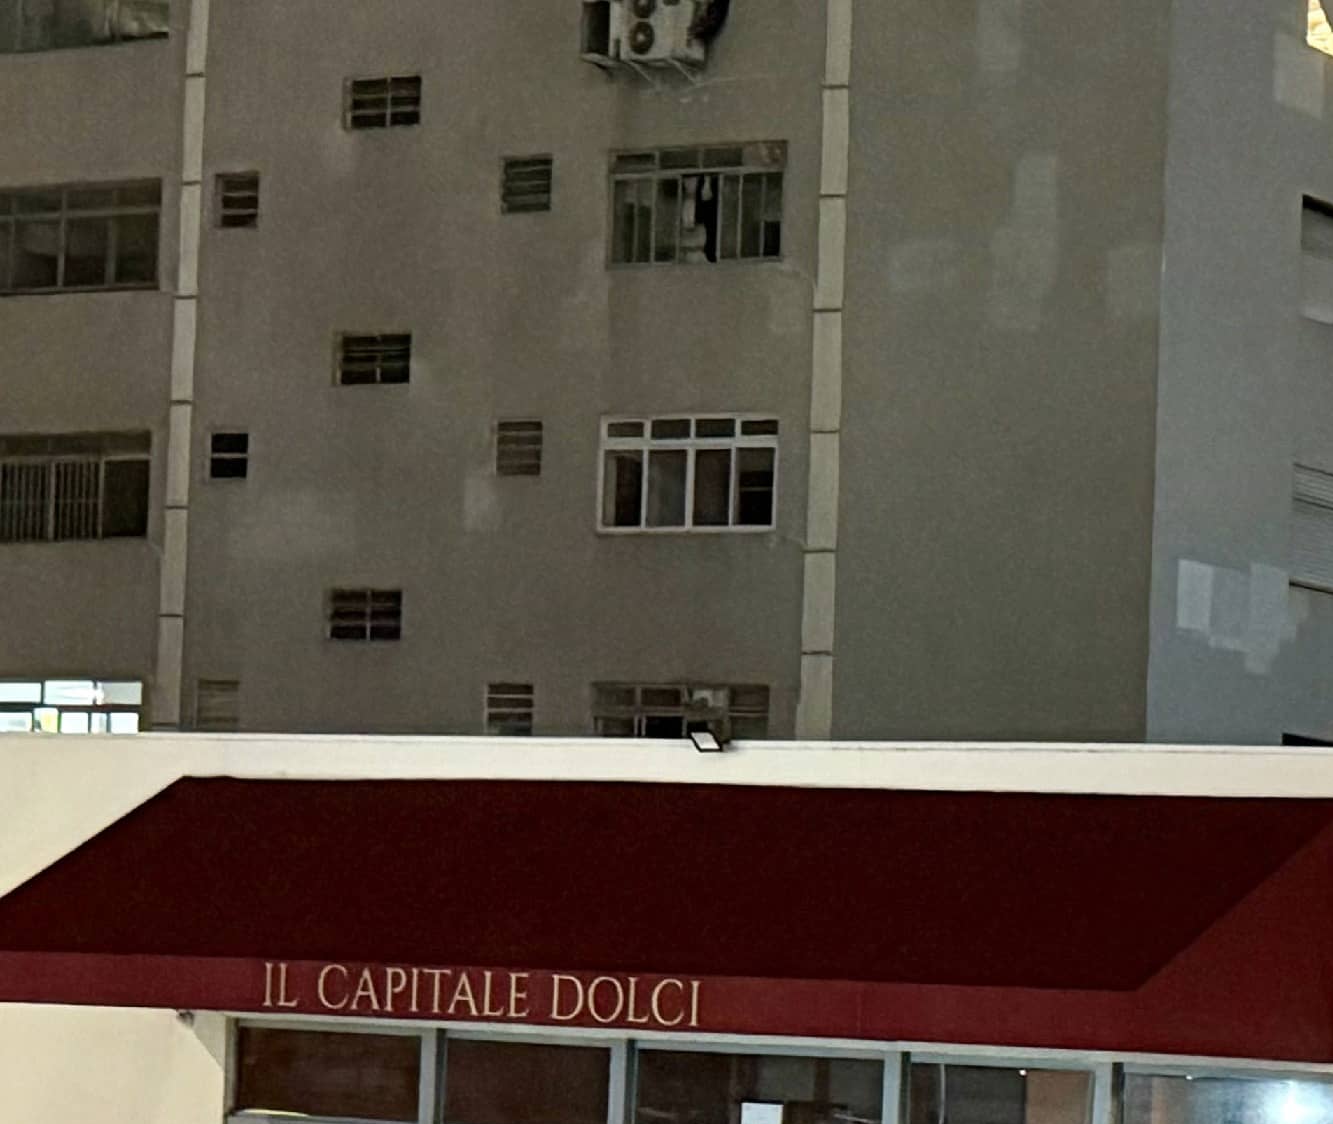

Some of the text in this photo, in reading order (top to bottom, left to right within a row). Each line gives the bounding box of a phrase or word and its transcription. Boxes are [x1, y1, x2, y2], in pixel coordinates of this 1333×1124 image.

[261, 961, 701, 1028] IL CAPITALE DOLCI
